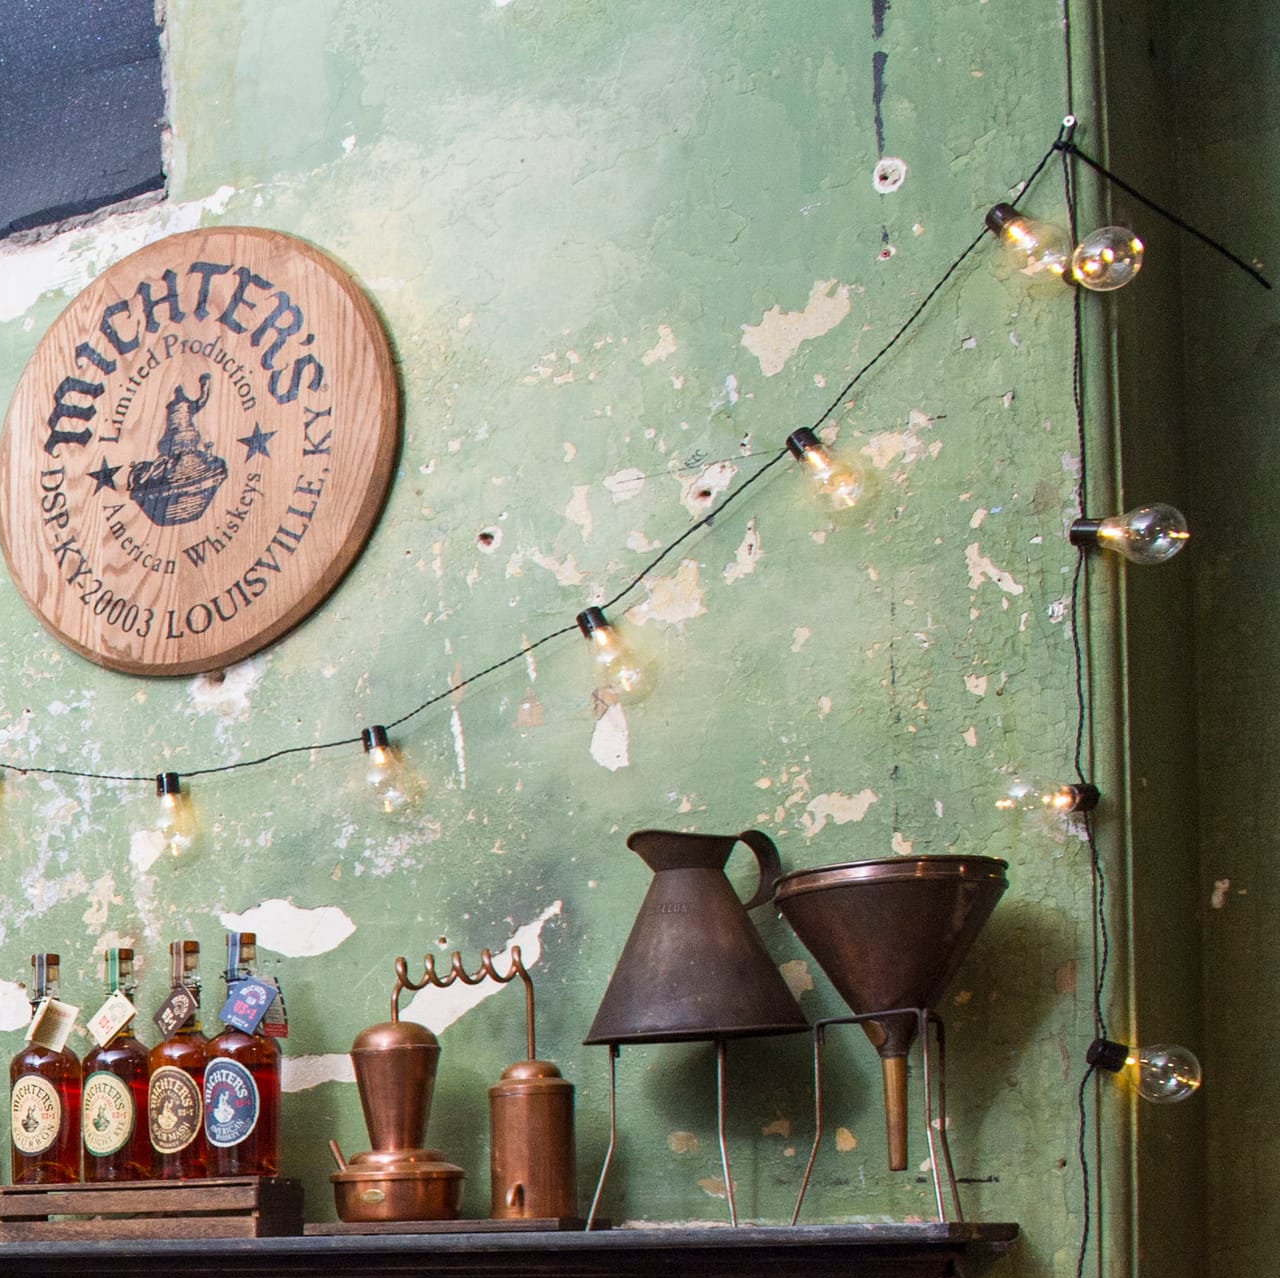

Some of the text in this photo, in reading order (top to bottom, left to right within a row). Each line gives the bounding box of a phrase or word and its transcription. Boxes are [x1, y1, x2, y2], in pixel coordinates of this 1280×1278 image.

[44, 262, 324, 459] MICHTER'S
[99, 334, 257, 443] Limited Production
[41, 466, 154, 638] DSP-KY-20003
[104, 472, 265, 575] American Whiskeys
[166, 406, 332, 640] LOUISVILLE, KY
